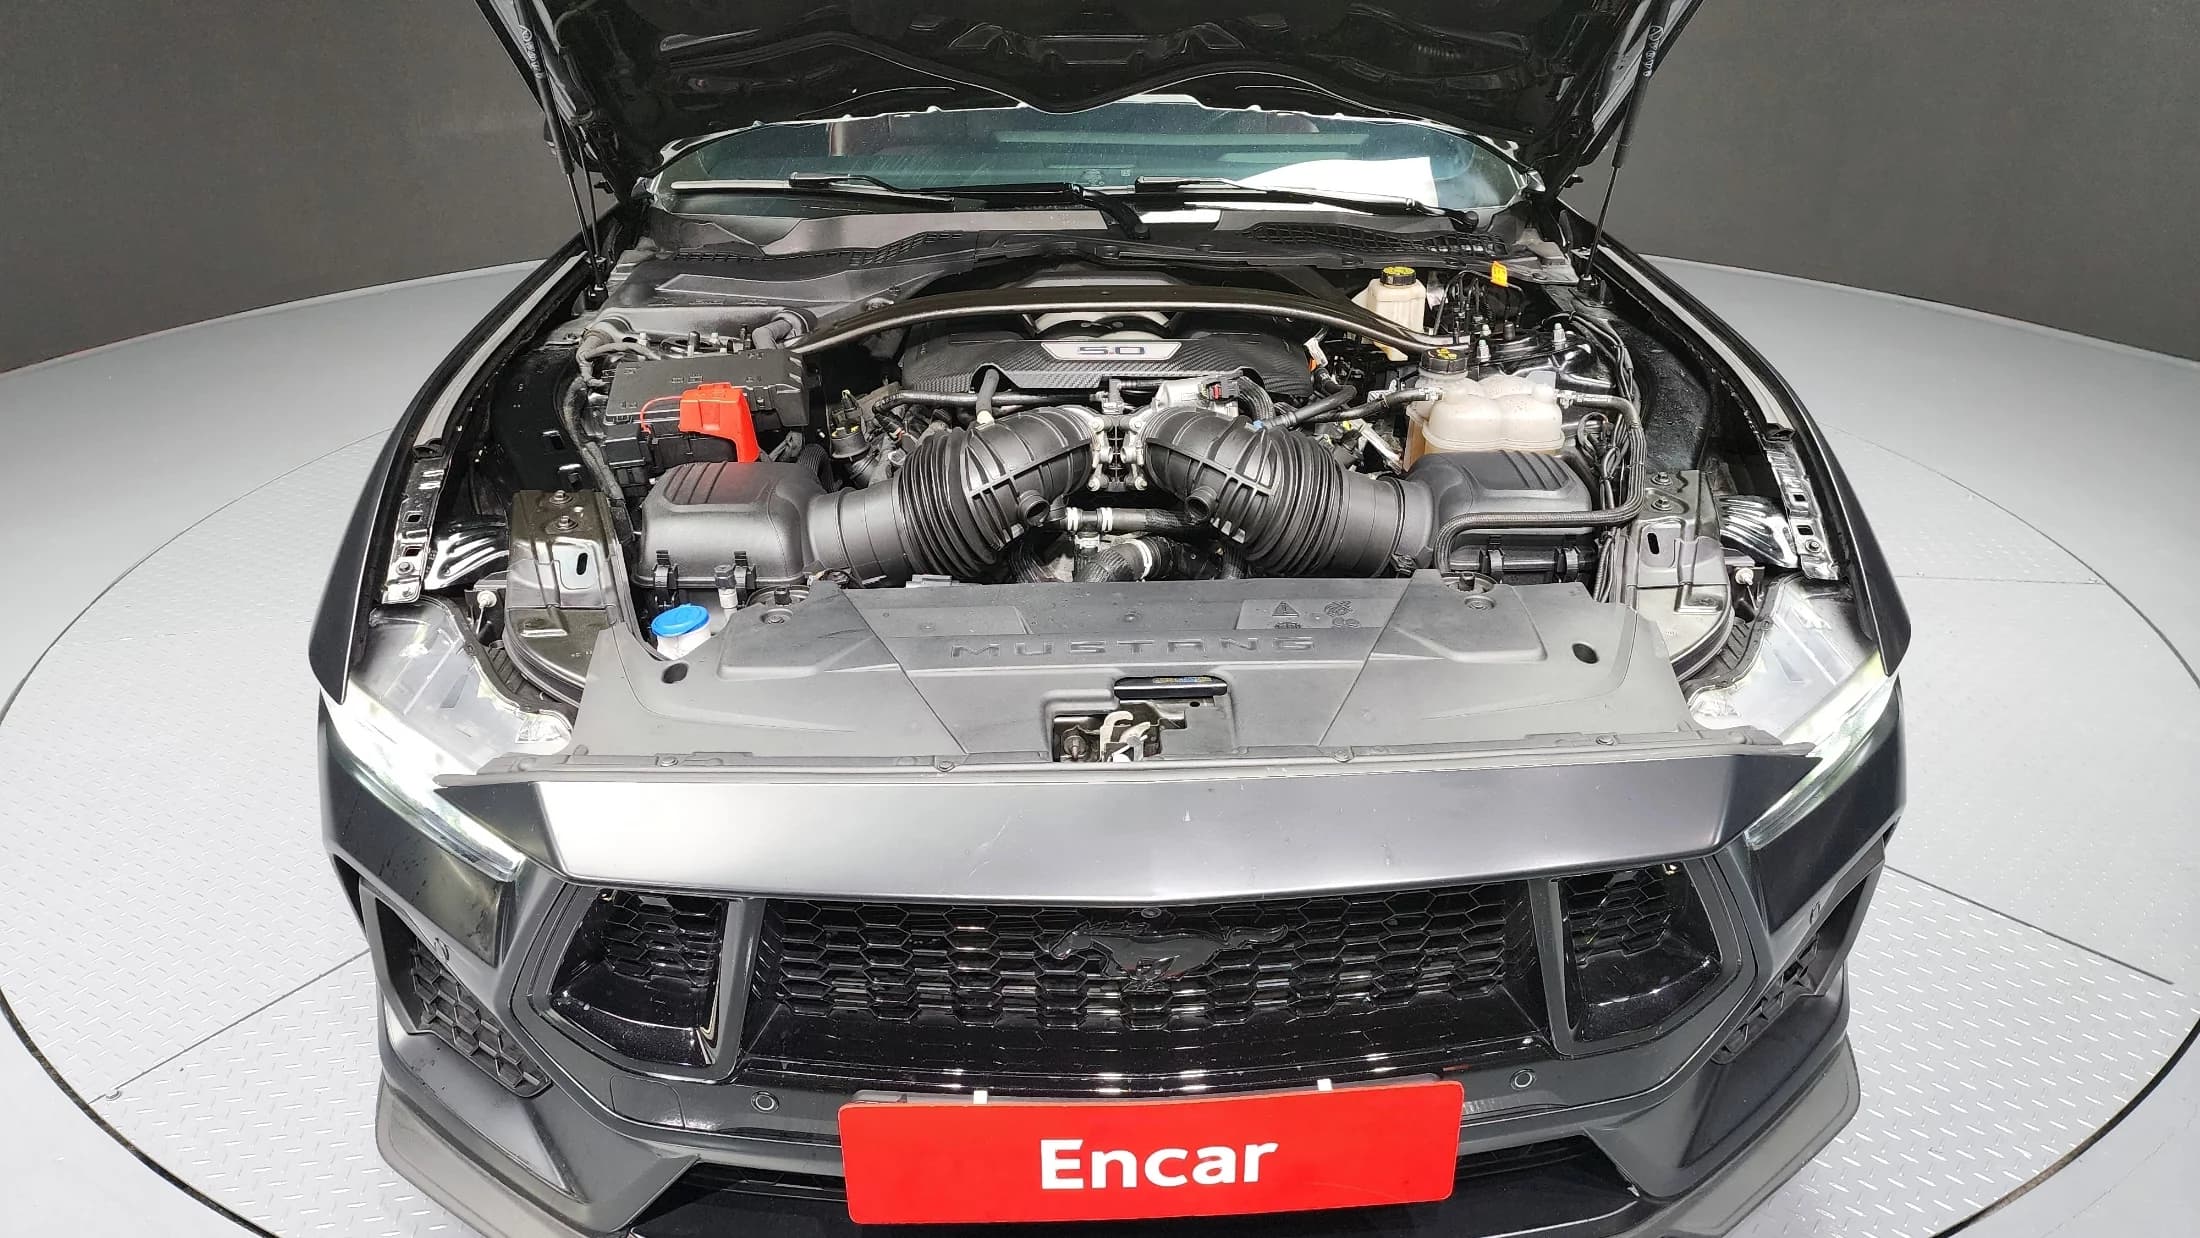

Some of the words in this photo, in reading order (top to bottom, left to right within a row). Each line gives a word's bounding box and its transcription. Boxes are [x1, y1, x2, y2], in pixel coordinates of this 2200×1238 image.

[1078, 346, 1145, 355] 5.0
[950, 636, 1315, 658] MUSTANG
[1040, 1139, 1279, 1190] Encar
